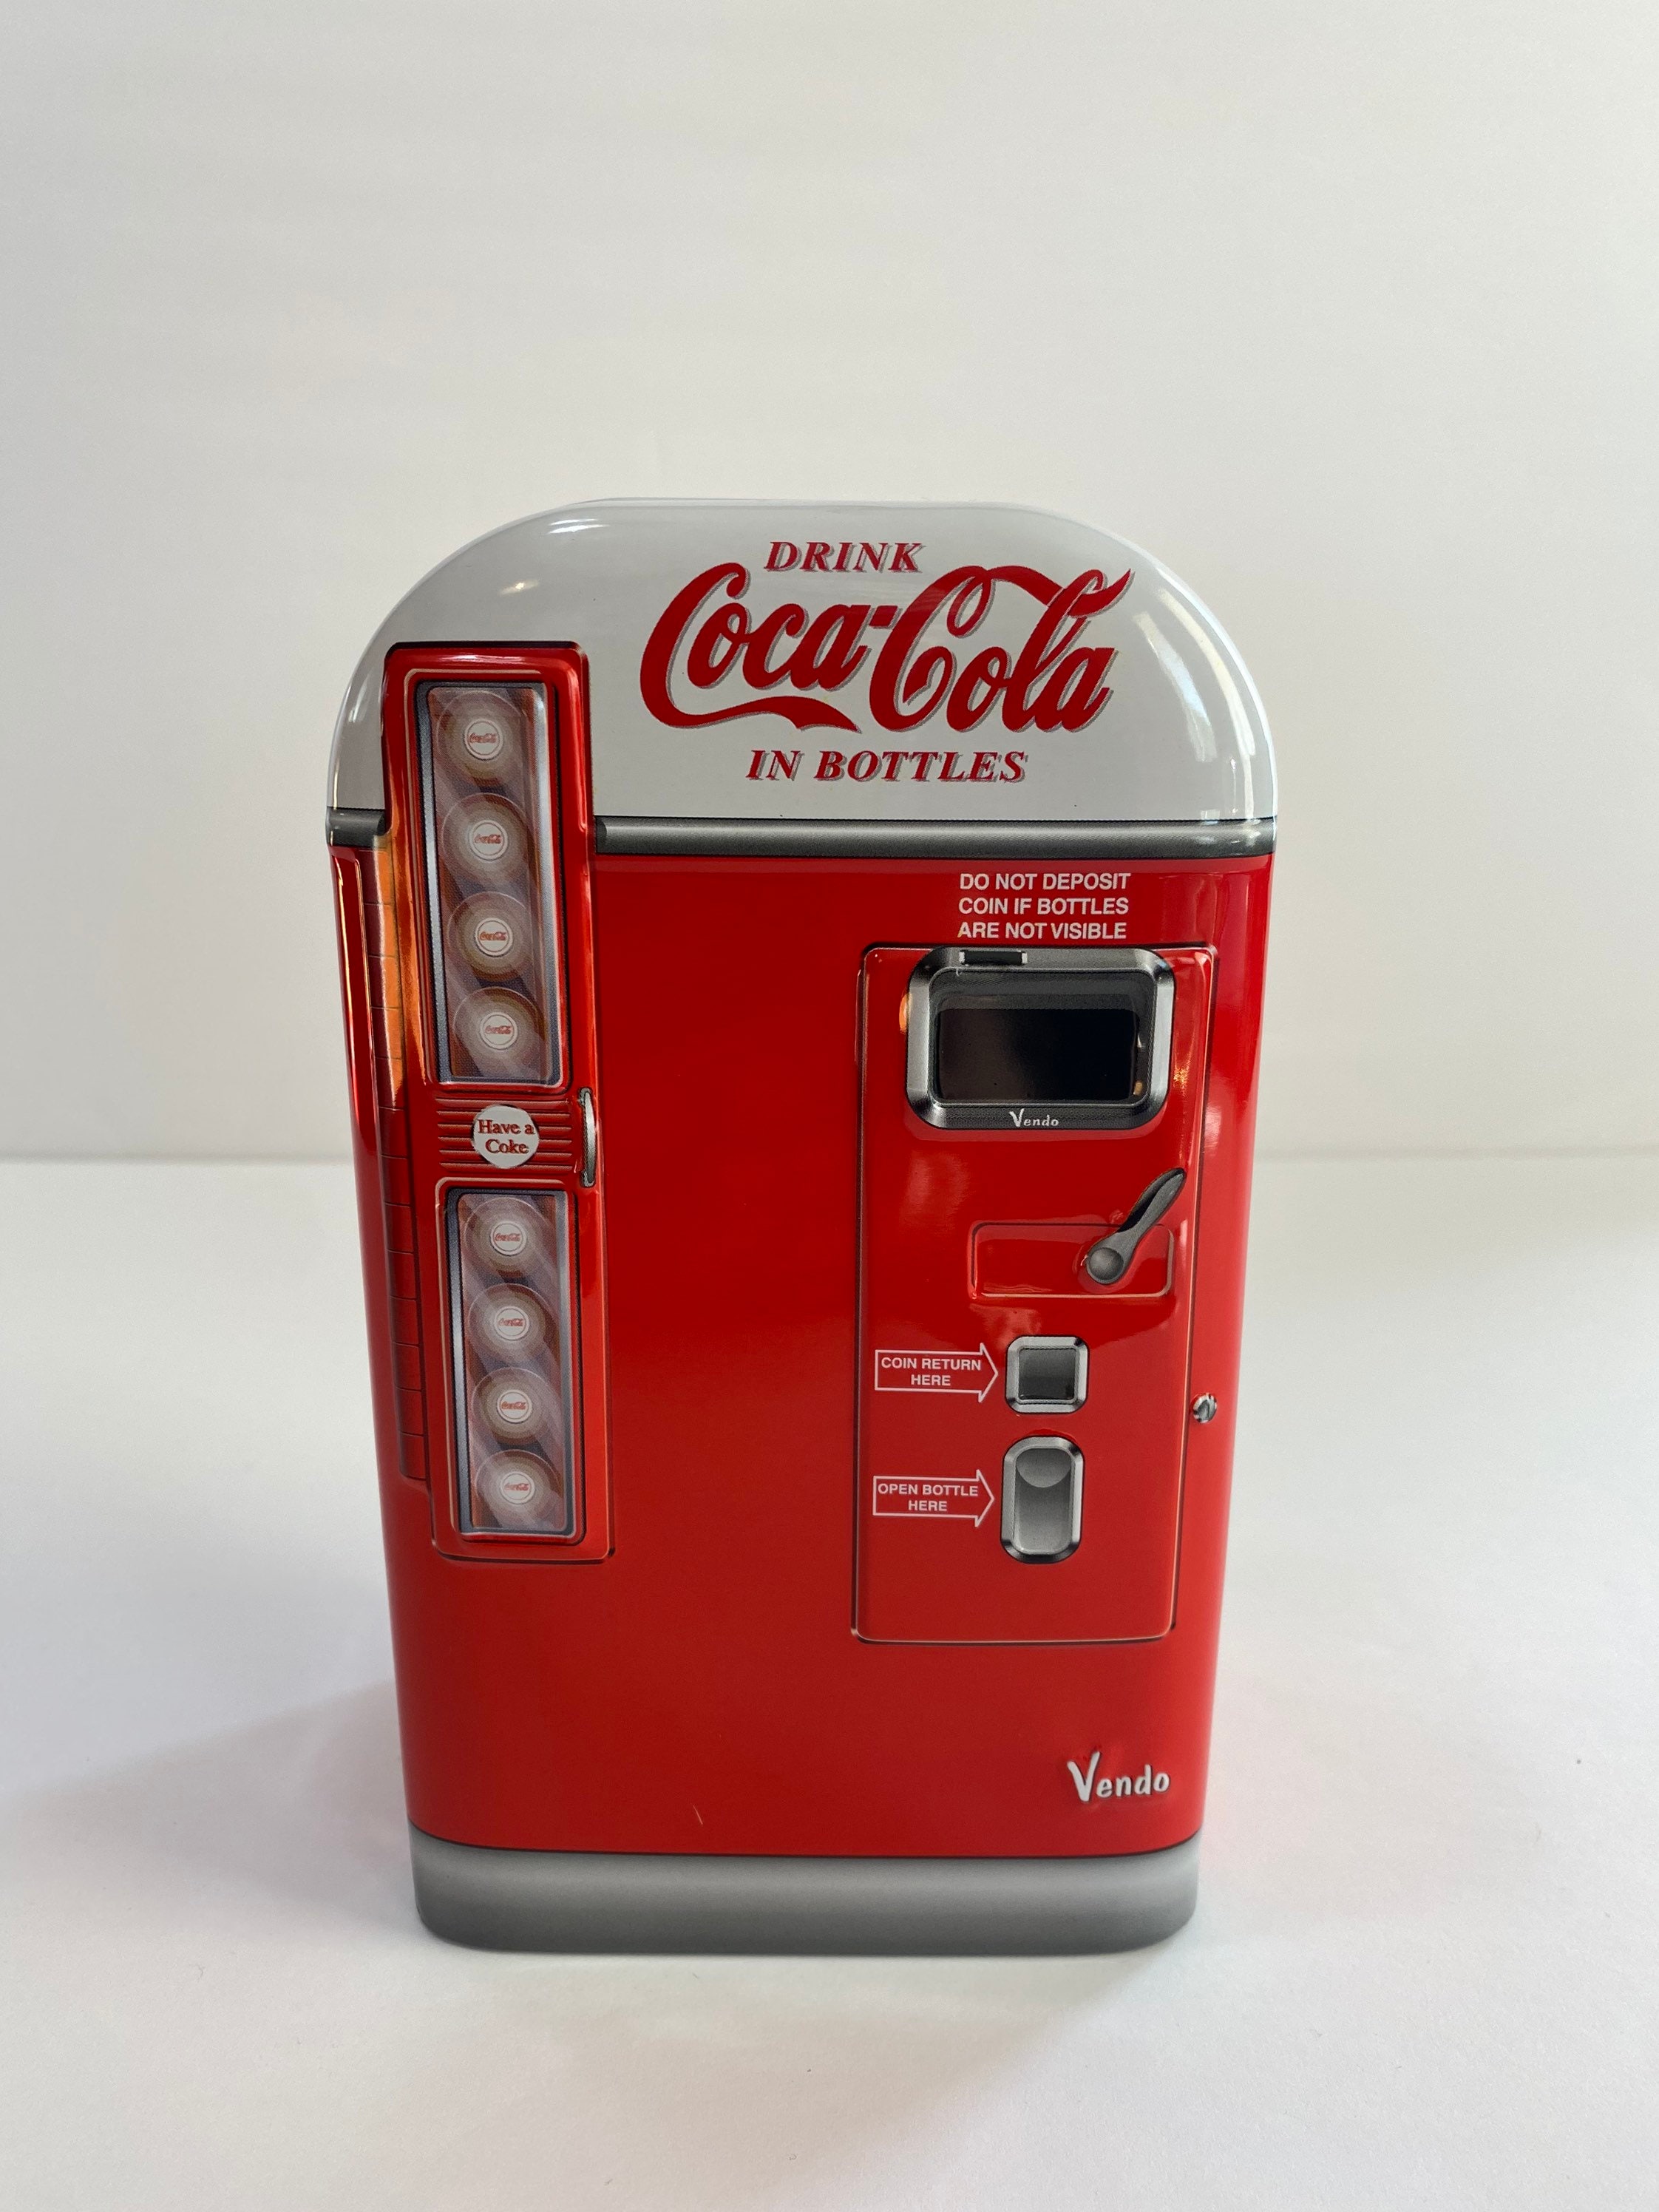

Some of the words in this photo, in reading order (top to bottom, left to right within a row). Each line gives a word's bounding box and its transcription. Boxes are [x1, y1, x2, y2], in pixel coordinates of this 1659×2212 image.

[764, 540, 926, 573] DRINK
[639, 563, 1133, 733] Coca-Cola
[746, 750, 805, 782] IN
[812, 750, 1028, 784] BOTTLES
[960, 873, 990, 890] DO
[995, 873, 1037, 890] NOT
[1042, 873, 1131, 890] DEPOSIT
[959, 898, 1008, 915] COIN
[1014, 898, 1032, 915] IF
[1037, 898, 1129, 915] BOTTLES
[957, 922, 999, 938] ARE
[1005, 922, 1047, 939] NOT
[1051, 922, 1127, 939] VISIBLE
[1008, 1108, 1059, 1127] Vendo
[478, 1119, 521, 1135] Have
[524, 1123, 535, 1135] a
[485, 1139, 529, 1154] Coke
[881, 1357, 917, 1369] COIN
[921, 1358, 981, 1371] RETURN
[911, 1374, 951, 1386] HERE
[878, 1483, 918, 1495] OPEN
[923, 1485, 978, 1496] BOTTLE
[908, 1500, 947, 1511] HERE
[1067, 1751, 1170, 1802] Vendo
